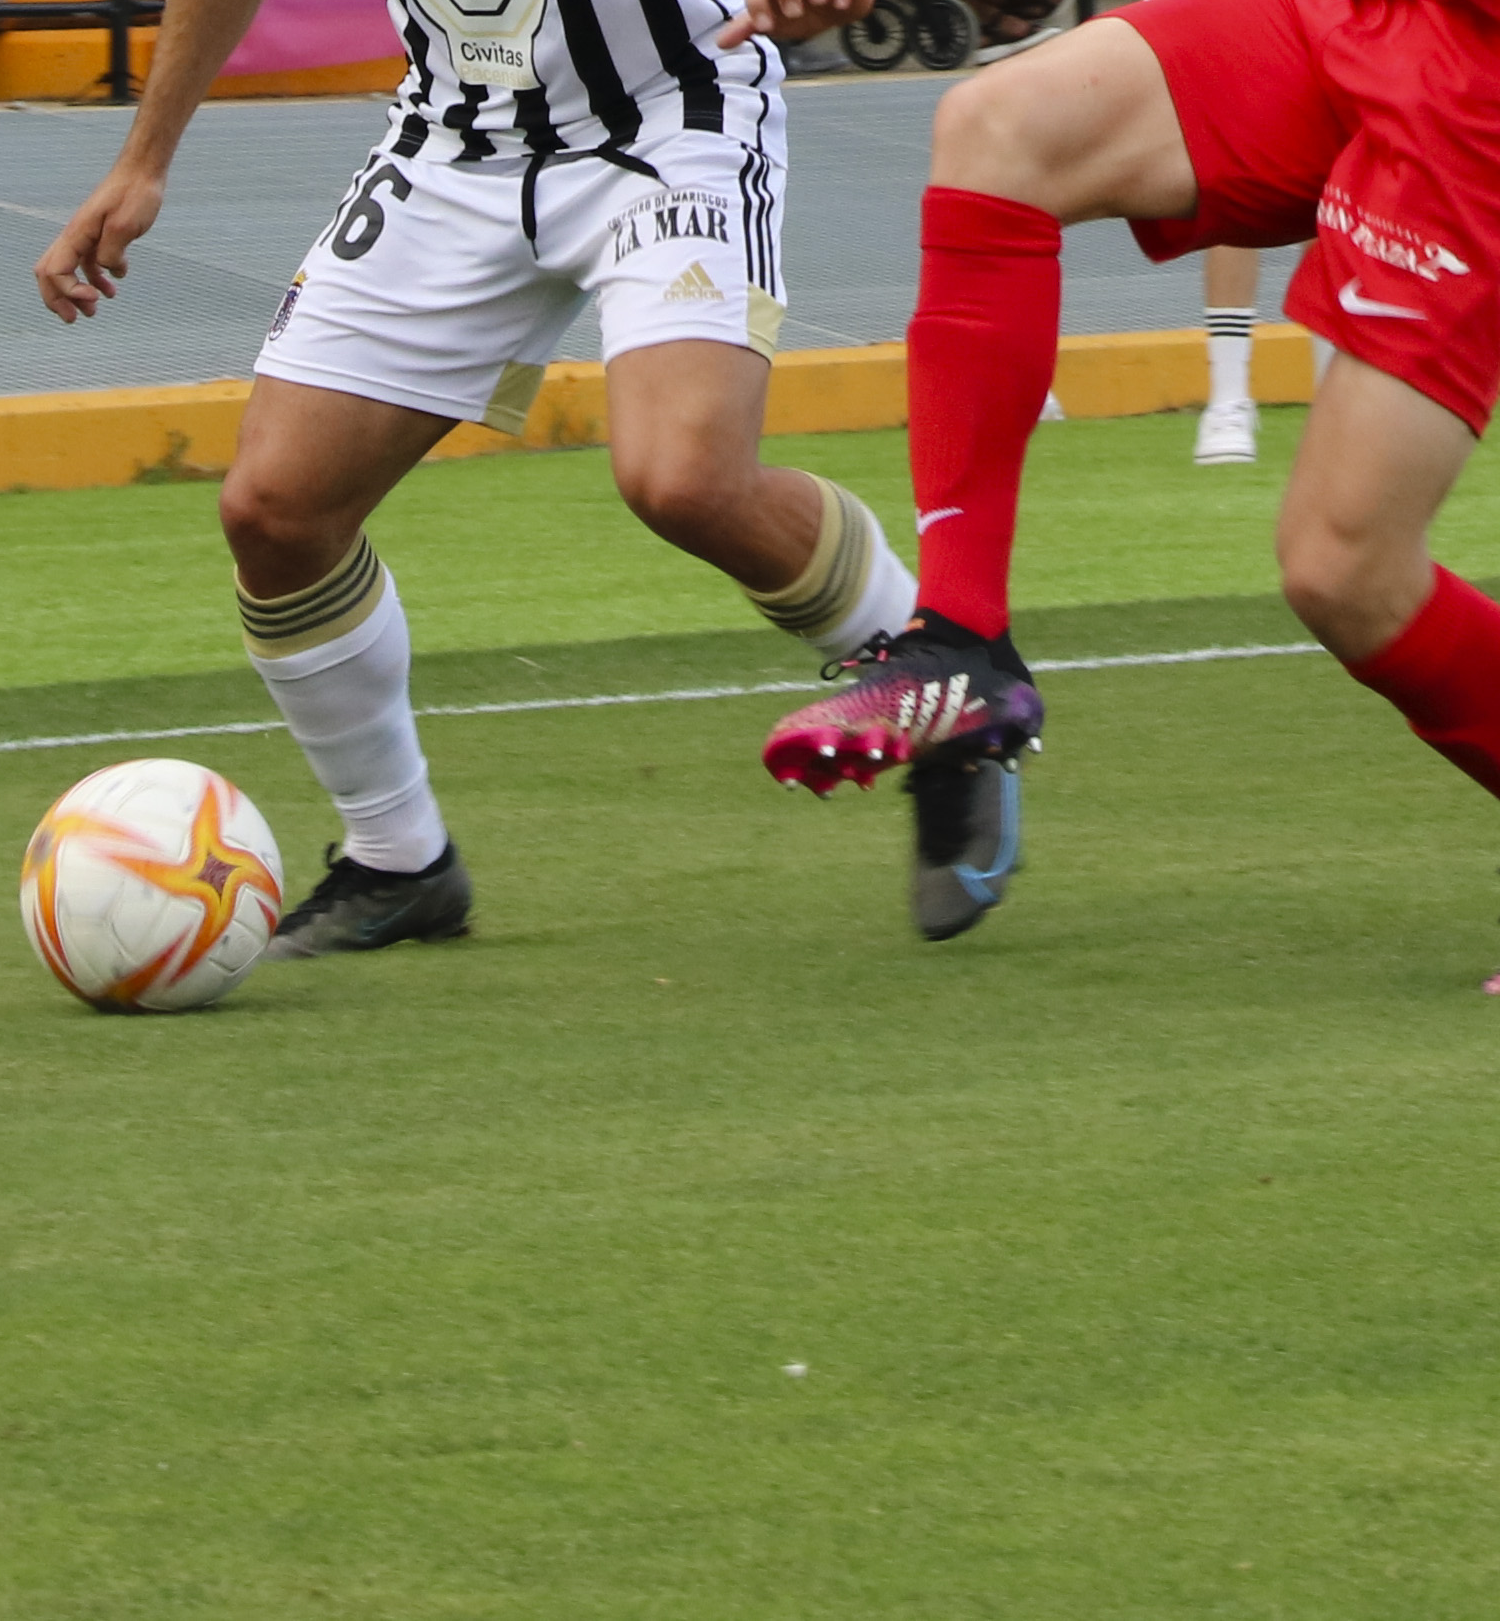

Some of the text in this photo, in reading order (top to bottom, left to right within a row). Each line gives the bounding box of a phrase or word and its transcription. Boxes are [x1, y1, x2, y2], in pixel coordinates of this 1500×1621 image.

[461, 41, 524, 68] Civitas
[614, 204, 730, 267] LA MAR
